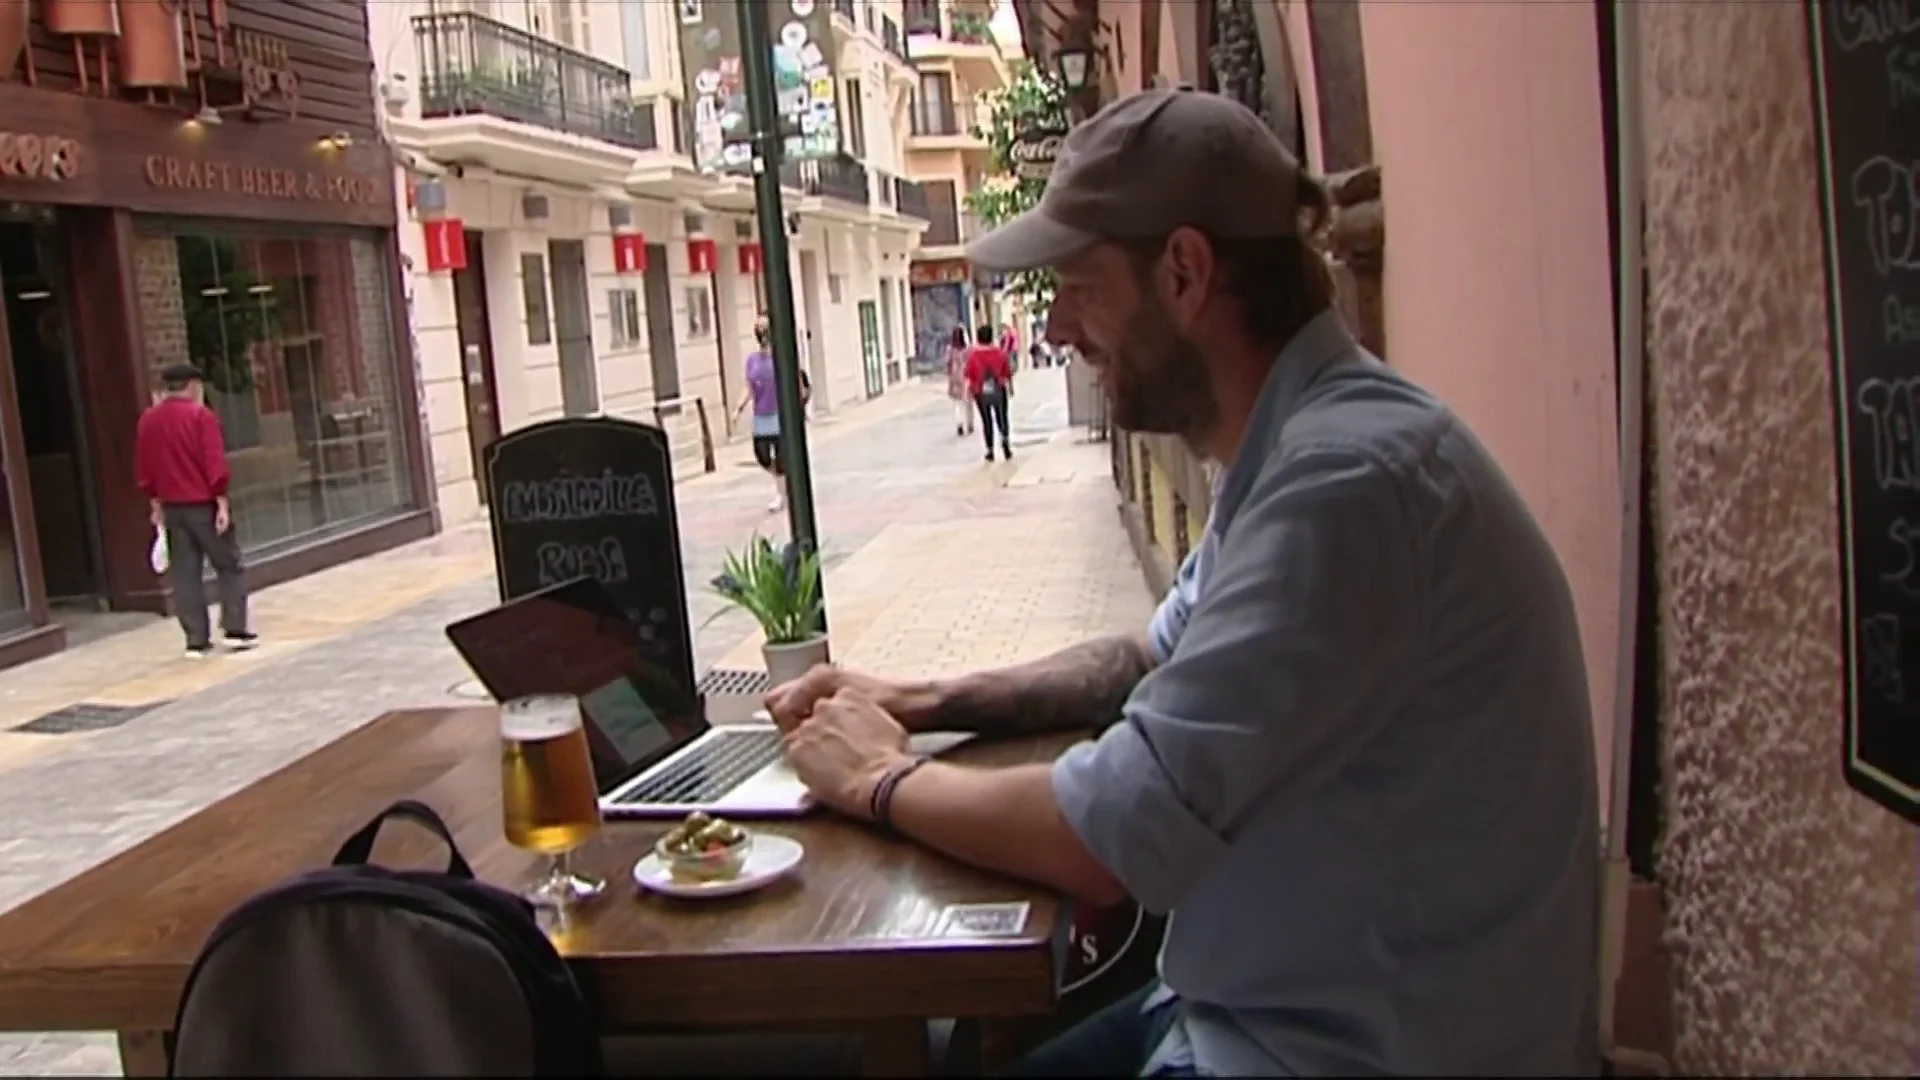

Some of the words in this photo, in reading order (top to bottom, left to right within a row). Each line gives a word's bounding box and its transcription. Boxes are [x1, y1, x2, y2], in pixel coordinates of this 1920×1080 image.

[145, 155, 231, 192] CRAFT
[240, 166, 299, 198] BEER
[304, 172, 322, 200] &
